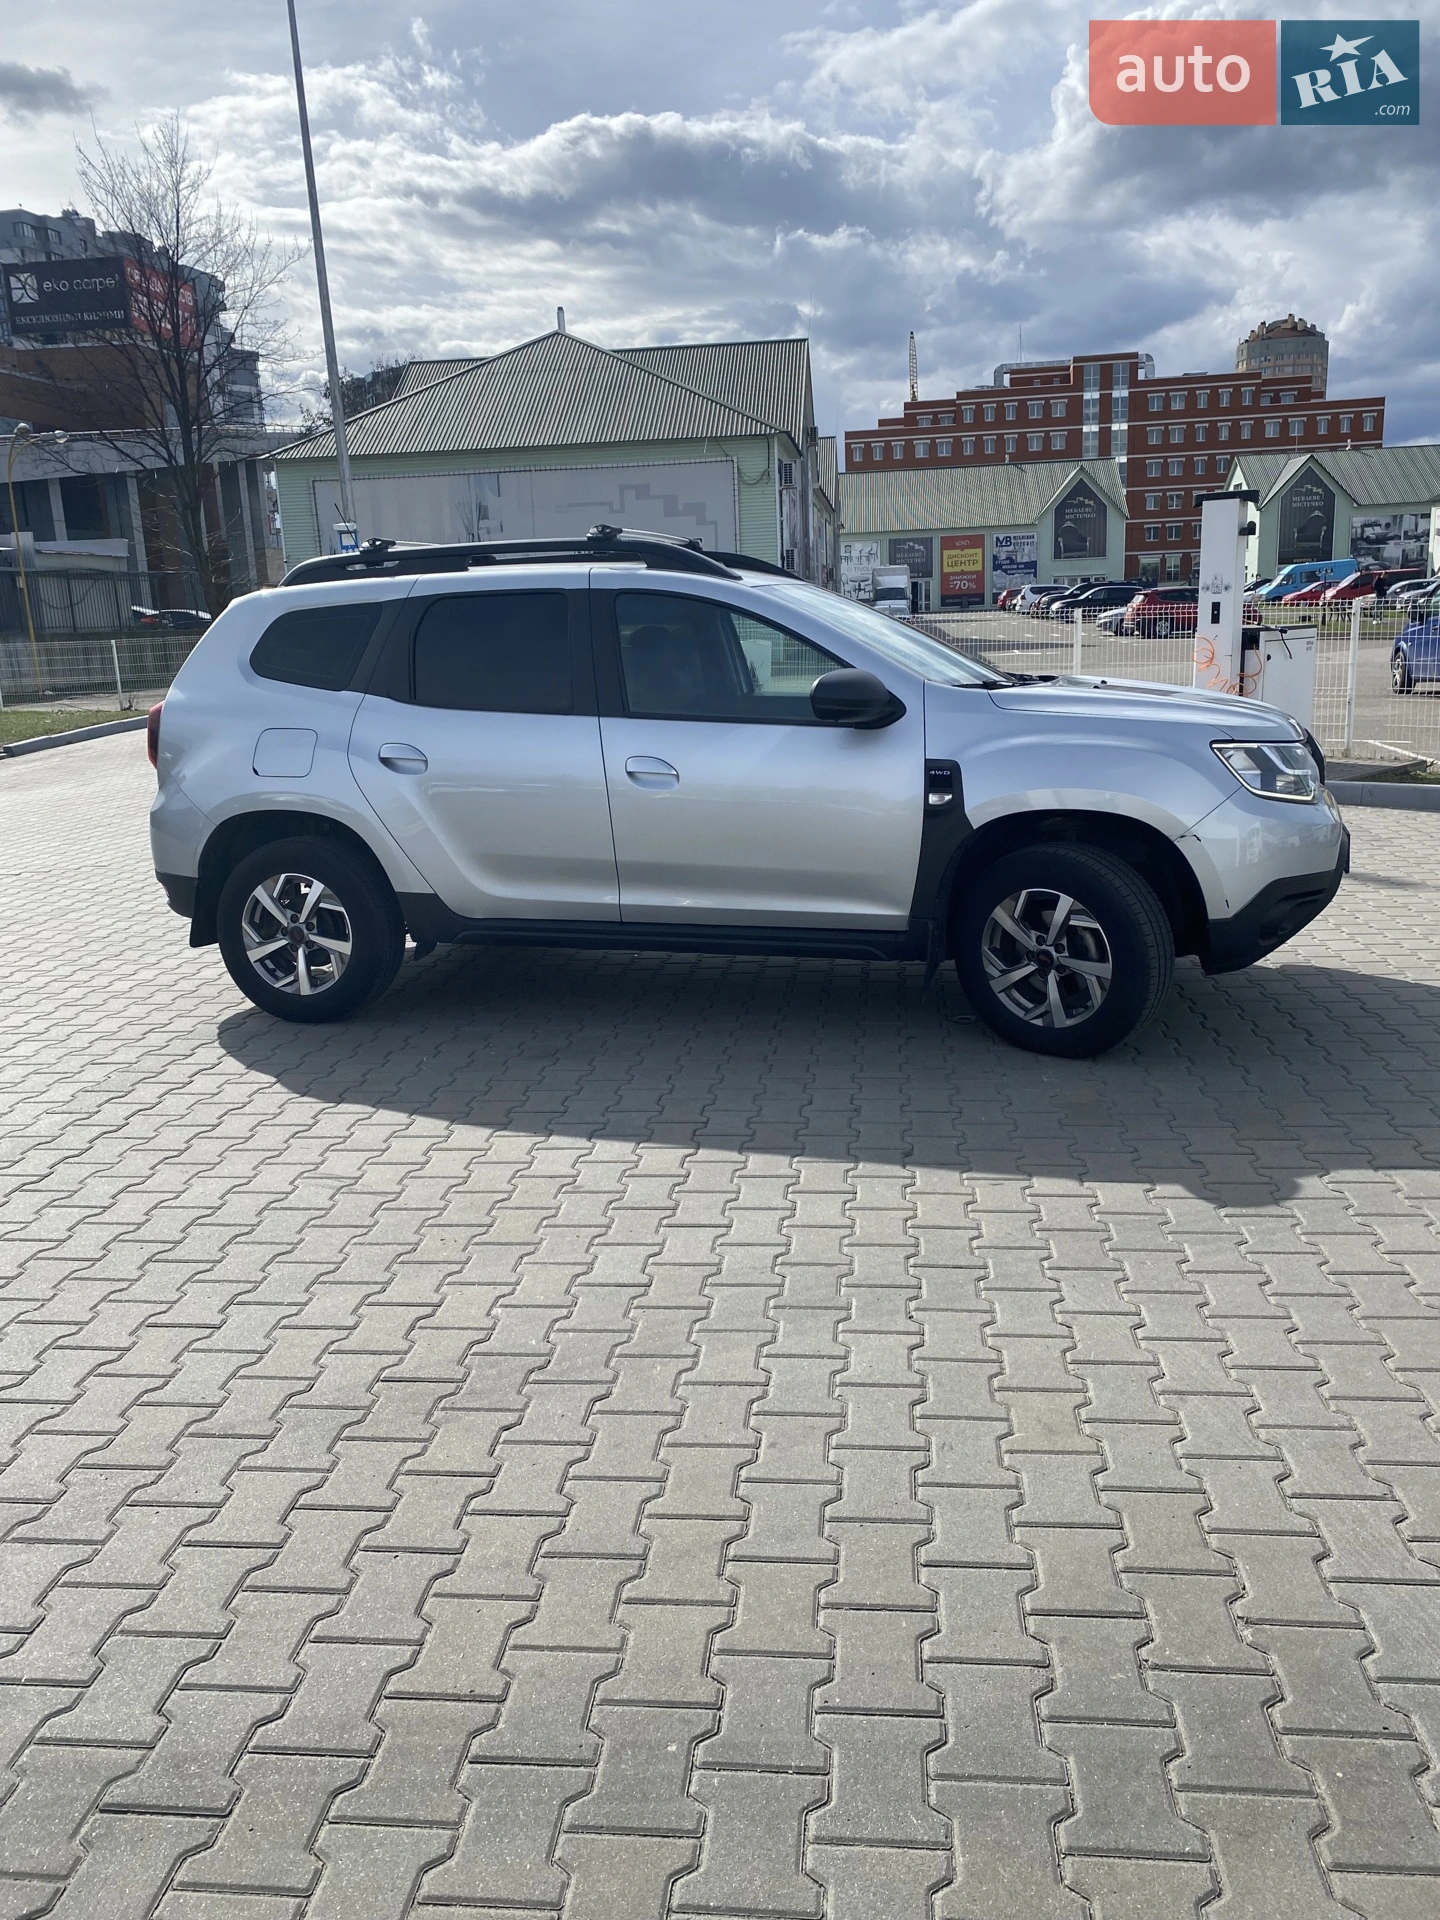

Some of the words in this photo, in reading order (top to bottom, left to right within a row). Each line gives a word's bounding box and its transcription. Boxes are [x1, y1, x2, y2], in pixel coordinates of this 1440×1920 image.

[43, 277, 69, 292] eko
[73, 273, 120, 292] carpet
[947, 552, 978, 560] ДИСКОНТ
[946, 559, 979, 568] ЦЕНТР
